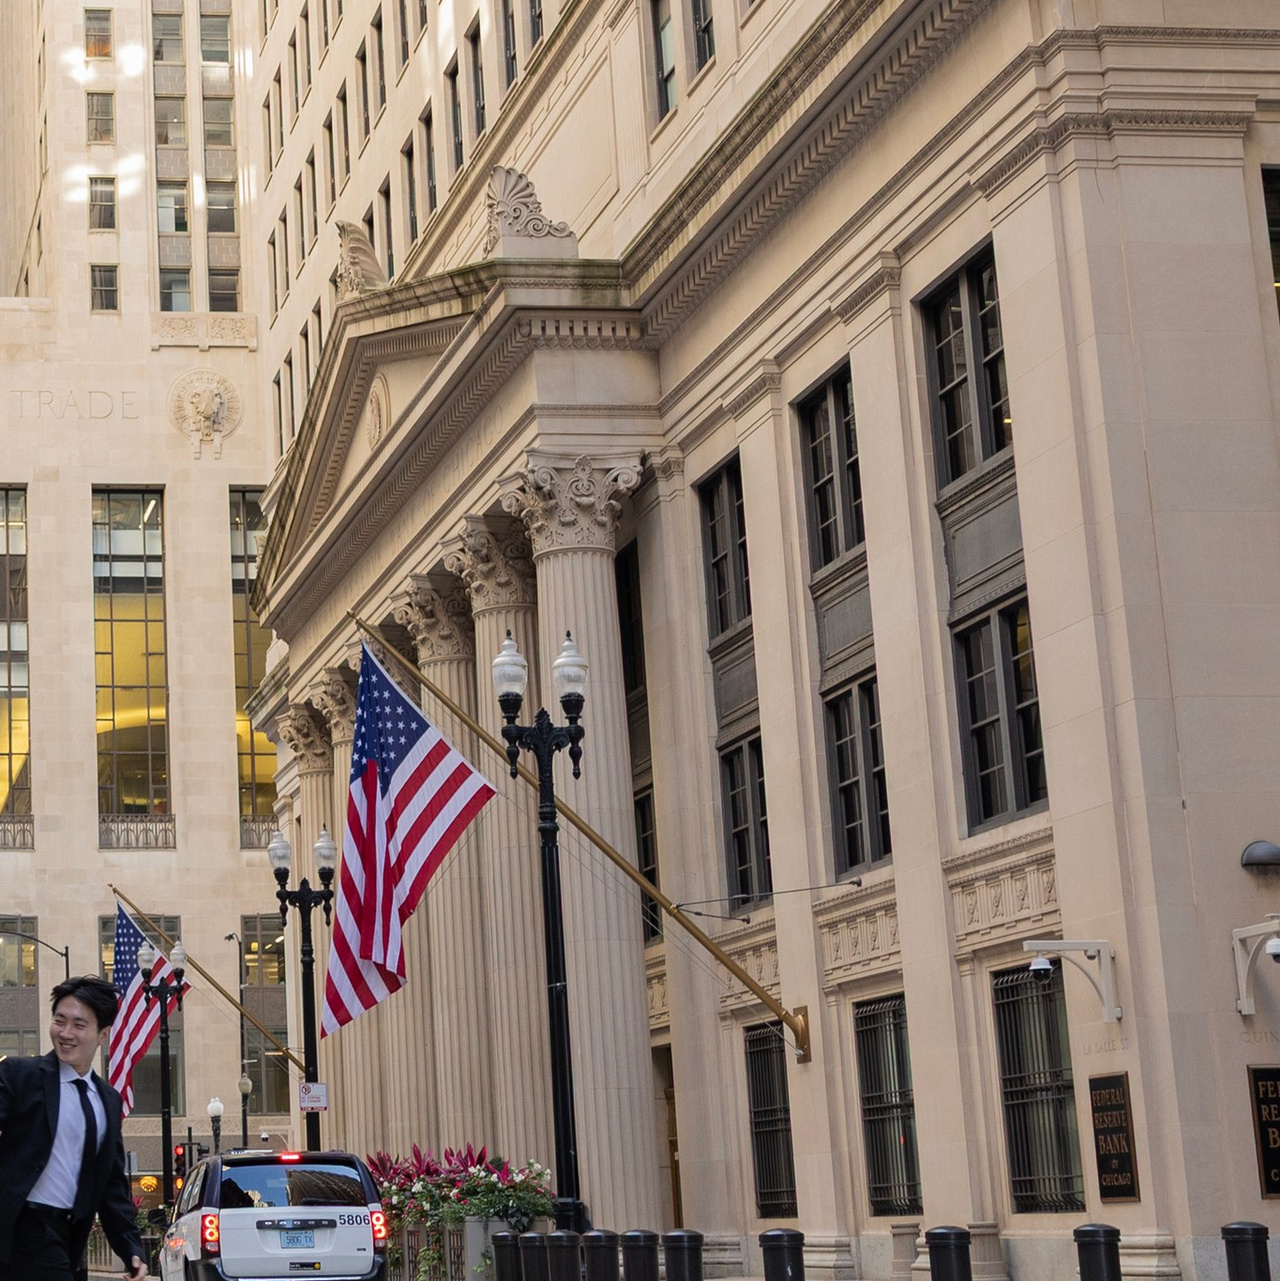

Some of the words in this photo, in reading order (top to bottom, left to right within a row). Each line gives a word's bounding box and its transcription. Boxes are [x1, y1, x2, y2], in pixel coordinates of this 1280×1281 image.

[10, 390, 140, 420] TRADE
[443, 404, 505, 494] CHICAGO
[1092, 1087, 1125, 1106] FEDERAL
[1094, 1110, 1127, 1129] RESERVE
[1098, 1133, 1129, 1154] BANK
[1101, 1173, 1131, 1186] CHICAGO
[339, 1214, 370, 1225] 5806
[286, 1235, 302, 1244] 5806
